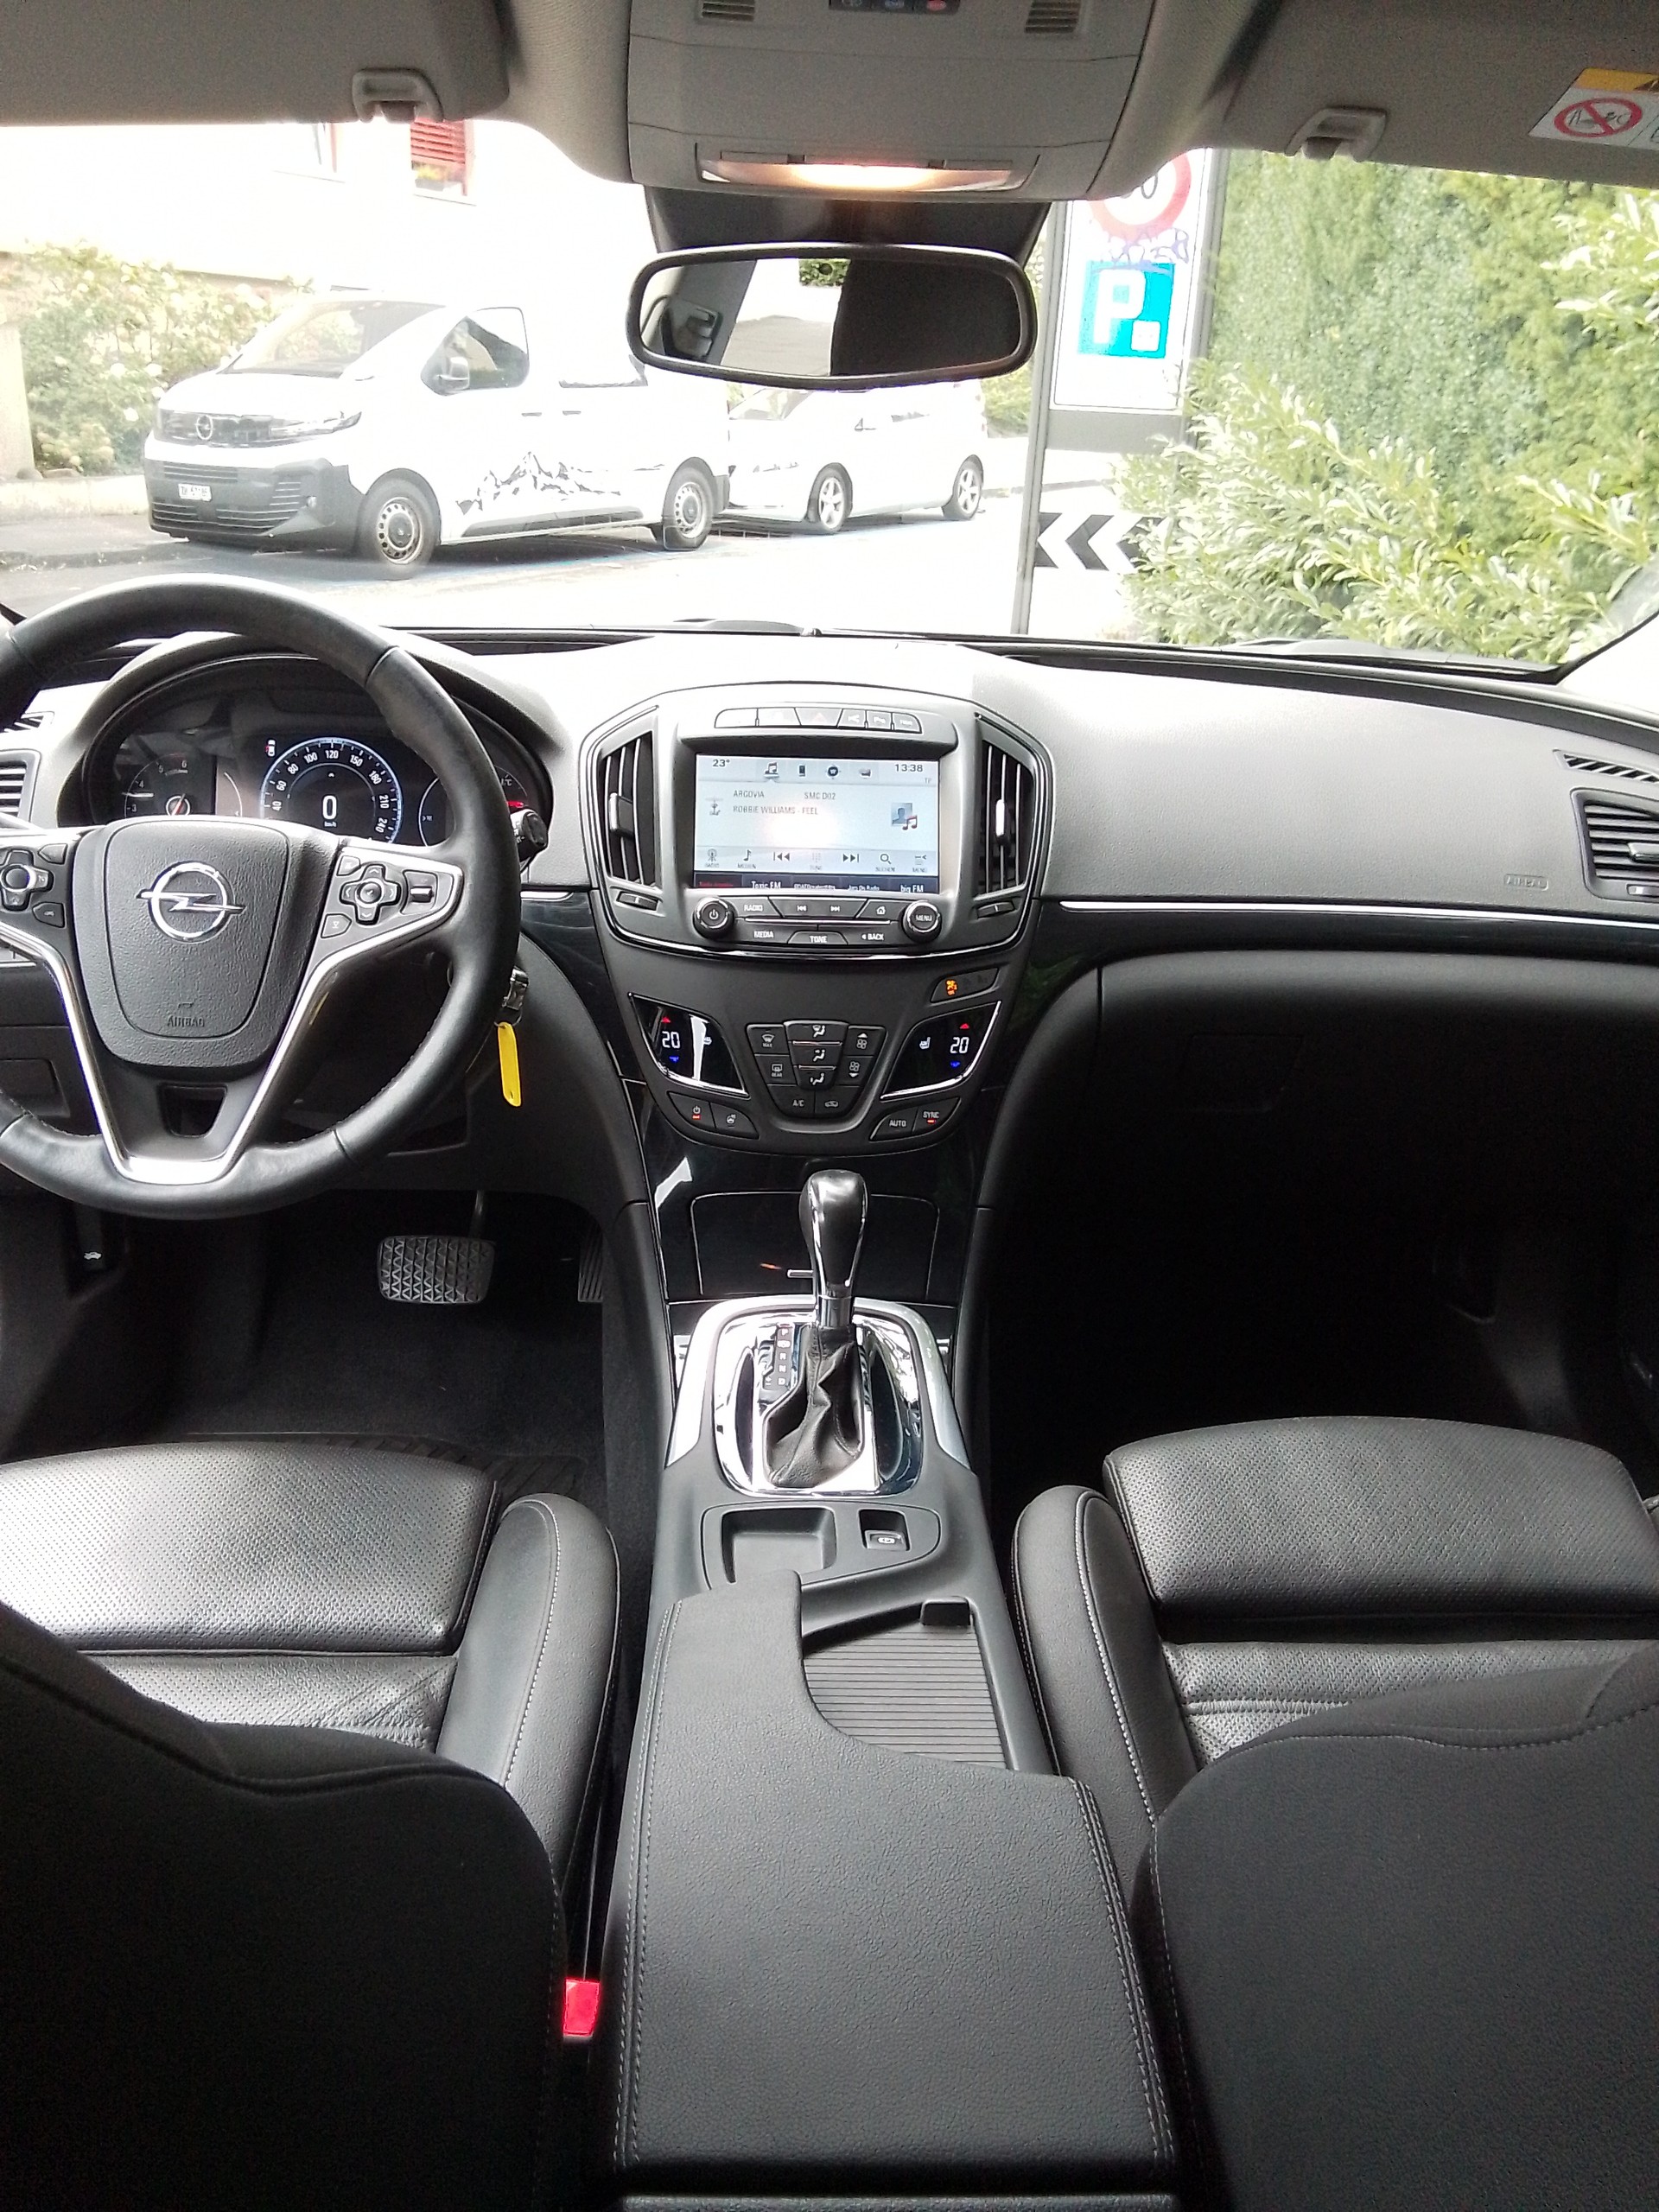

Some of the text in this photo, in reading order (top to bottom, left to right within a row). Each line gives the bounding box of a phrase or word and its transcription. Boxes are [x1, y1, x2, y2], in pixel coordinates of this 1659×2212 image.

[1092, 269, 1147, 345] P
[304, 753, 318, 764] 100
[325, 750, 339, 759] 120
[350, 754, 364, 766] 150
[287, 764, 300, 775] 80
[368, 770, 382, 785] 180
[276, 780, 287, 791] 60
[733, 790, 765, 798] ARGOVIA
[804, 791, 821, 800] SMC
[271, 800, 282, 811] 40
[378, 794, 390, 809] 210
[322, 795, 337, 820] 0
[760, 805, 796, 814] WILLIAMS
[375, 817, 388, 833] 240
[662, 1031, 681, 1049] 20
[950, 1037, 969, 1053] 20
[889, 1119, 906, 1128] AUTO
